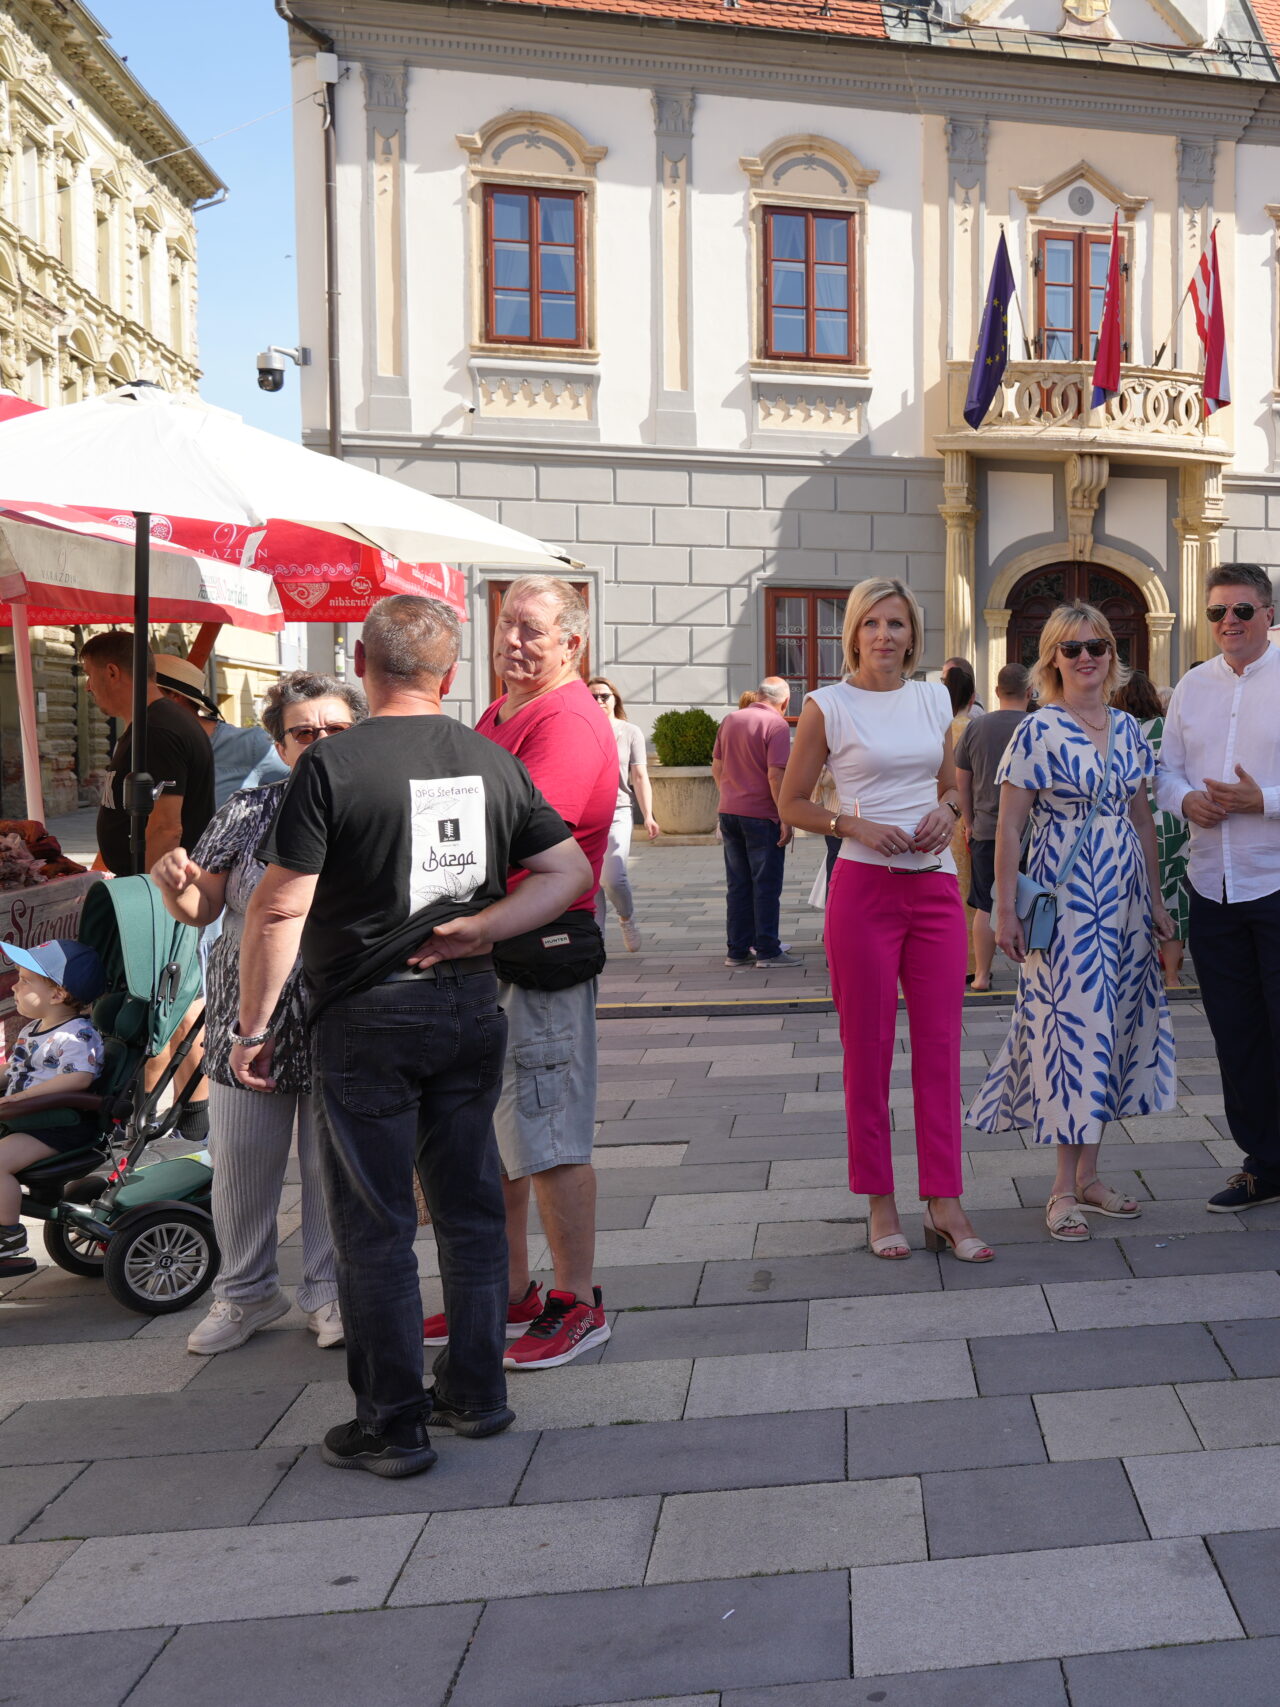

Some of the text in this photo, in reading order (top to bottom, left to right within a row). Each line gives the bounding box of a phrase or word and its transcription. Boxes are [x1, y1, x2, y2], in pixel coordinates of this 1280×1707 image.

[415, 786, 479, 798] OPG Štefanec
[422, 846, 477, 875] Bazga
[544, 936, 568, 945] HUNTER
